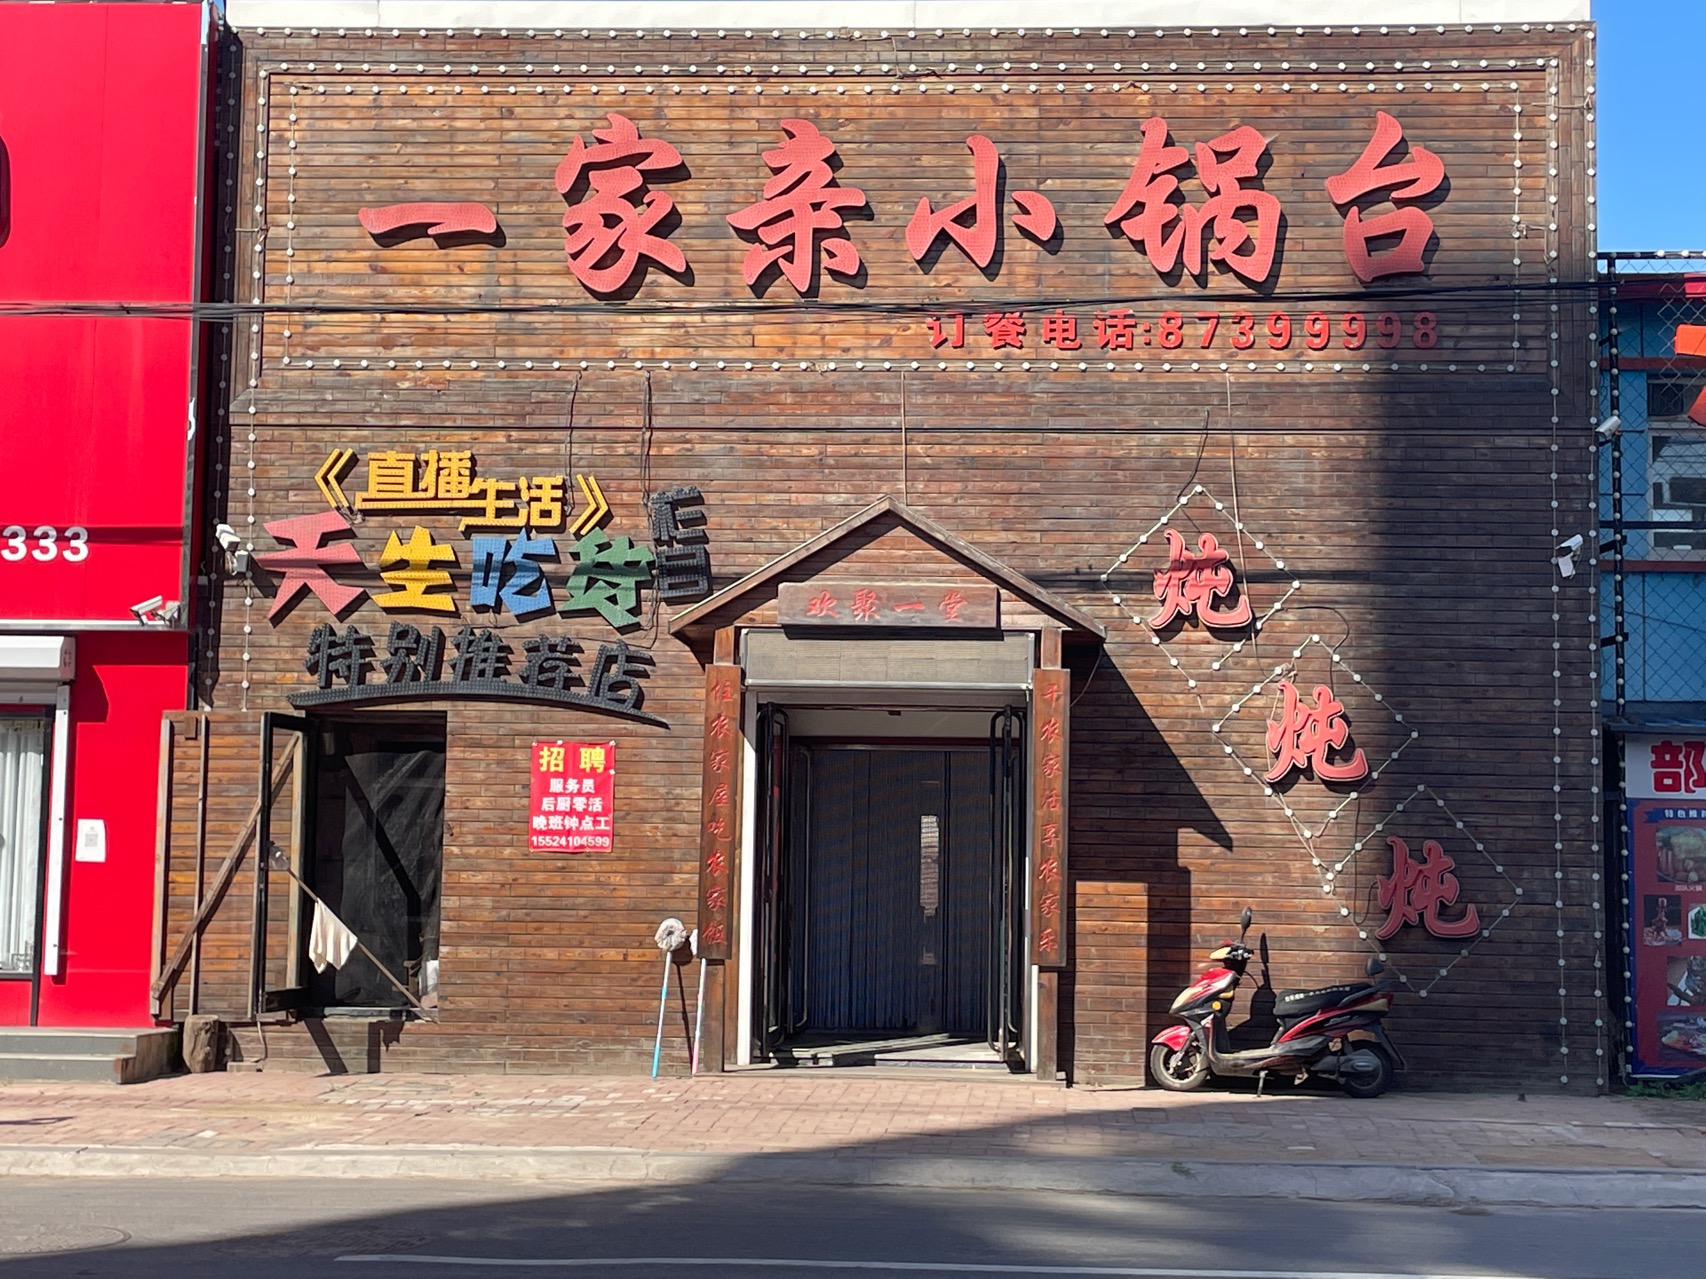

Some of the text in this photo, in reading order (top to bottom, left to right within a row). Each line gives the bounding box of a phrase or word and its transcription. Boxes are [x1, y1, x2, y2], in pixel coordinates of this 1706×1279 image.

[358, 111, 1446, 294] 一家亲小锅台
[1, 525, 89, 562] 333
[256, 509, 656, 631] 天生吃货
[1149, 528, 1253, 629] 炖
[806, 588, 968, 621] 欢聚一堂
[304, 620, 653, 713] 特别推荐店
[1264, 680, 1369, 782] 炖
[539, 746, 606, 773] 招聘
[549, 778, 595, 793] 服务员
[532, 815, 610, 831] 晚班钟点工
[541, 797, 603, 812] 后厨零活
[531, 836, 610, 847] 15524104599
[1375, 836, 1480, 940] 炖
